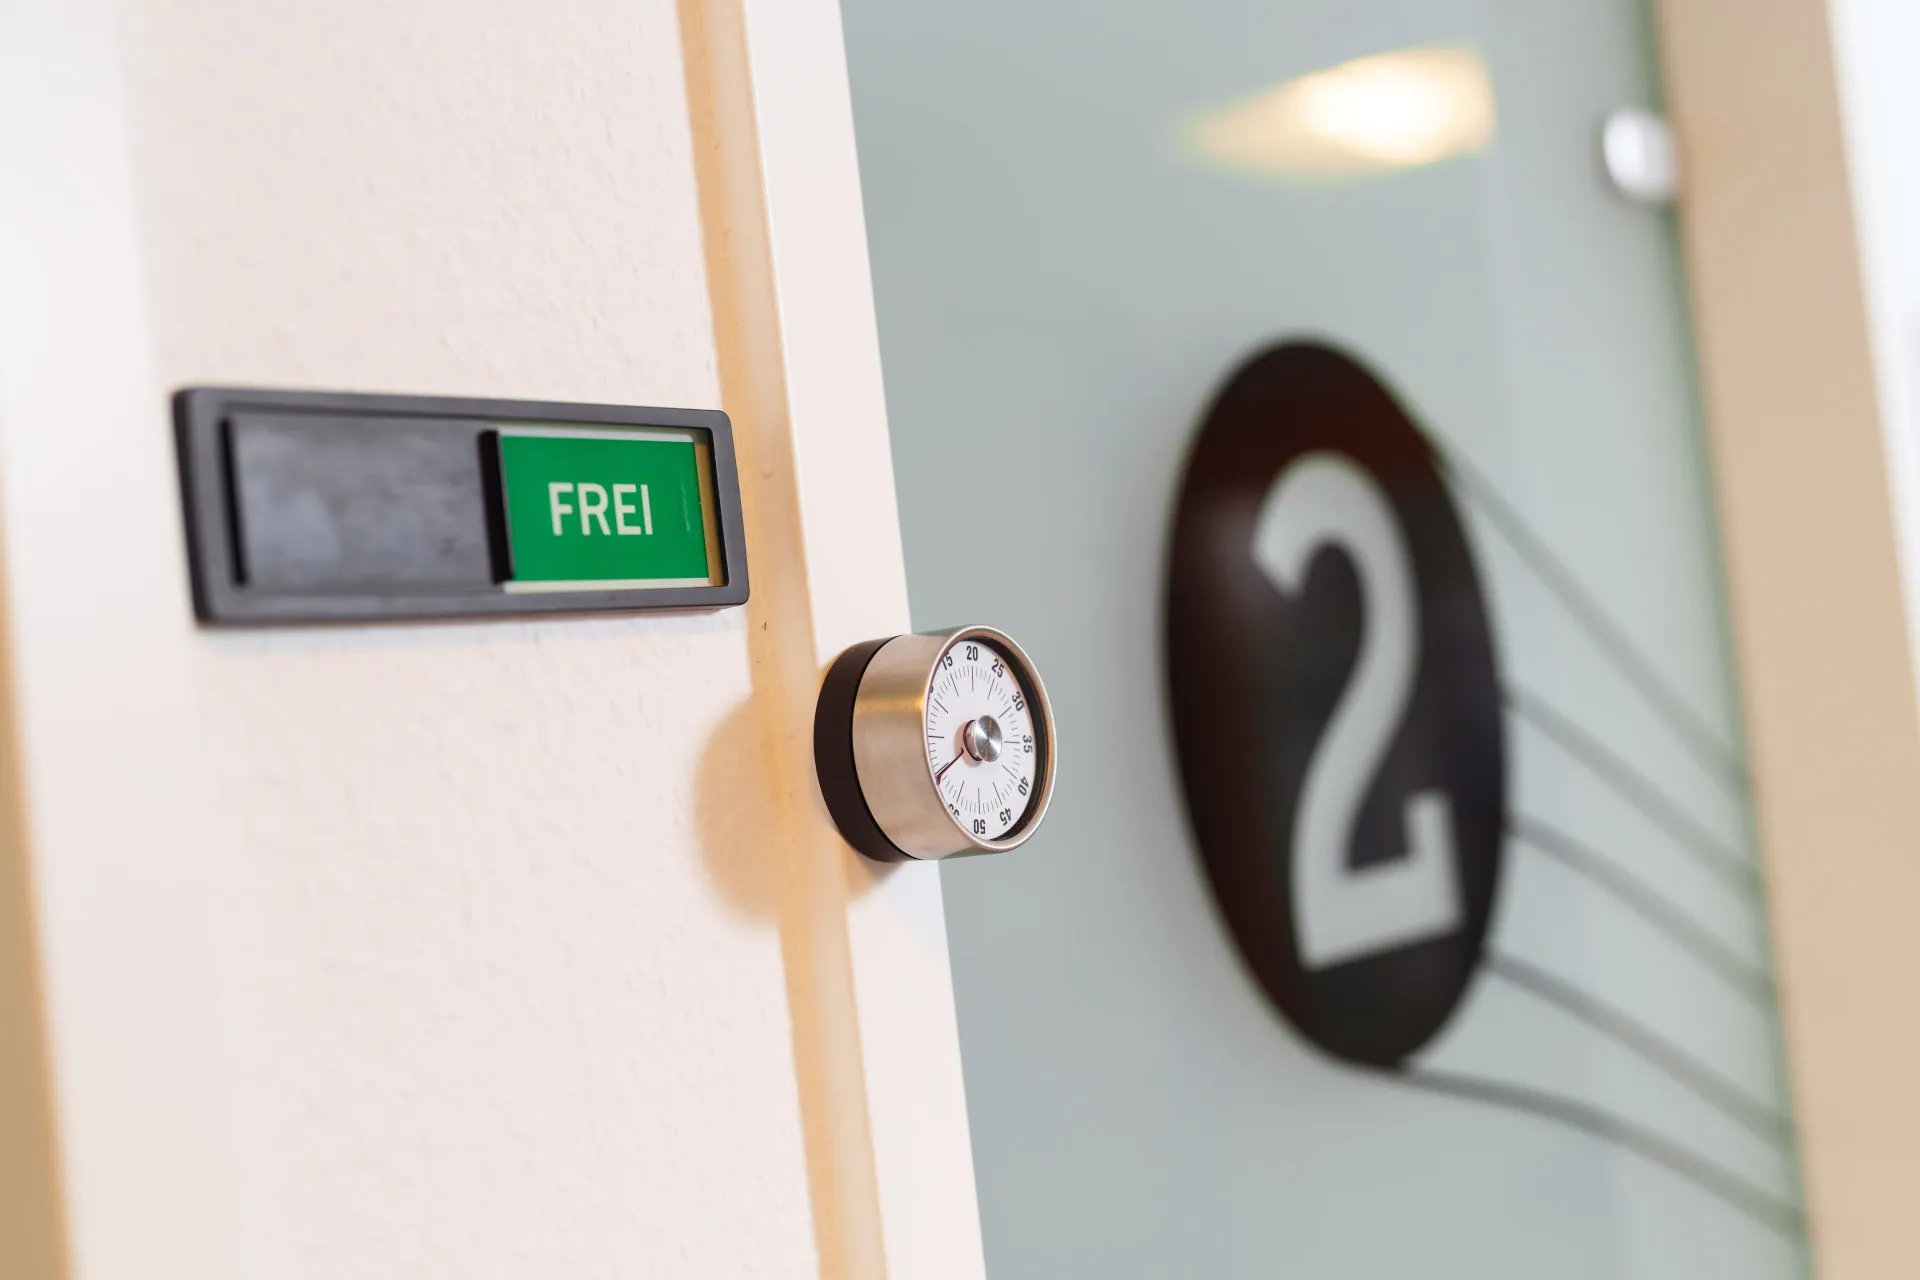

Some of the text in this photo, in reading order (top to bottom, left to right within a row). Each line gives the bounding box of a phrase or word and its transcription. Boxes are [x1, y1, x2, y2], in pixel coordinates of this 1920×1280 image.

[548, 482, 654, 536] FREI
[942, 652, 954, 670] 15
[966, 646, 979, 661] 20
[991, 659, 1005, 678] 25
[1011, 692, 1025, 712] 30
[1252, 450, 1465, 972] 2
[1022, 734, 1033, 753] 35
[1017, 776, 1030, 796] 40
[999, 807, 1012, 826] 45
[973, 819, 986, 834] 50
